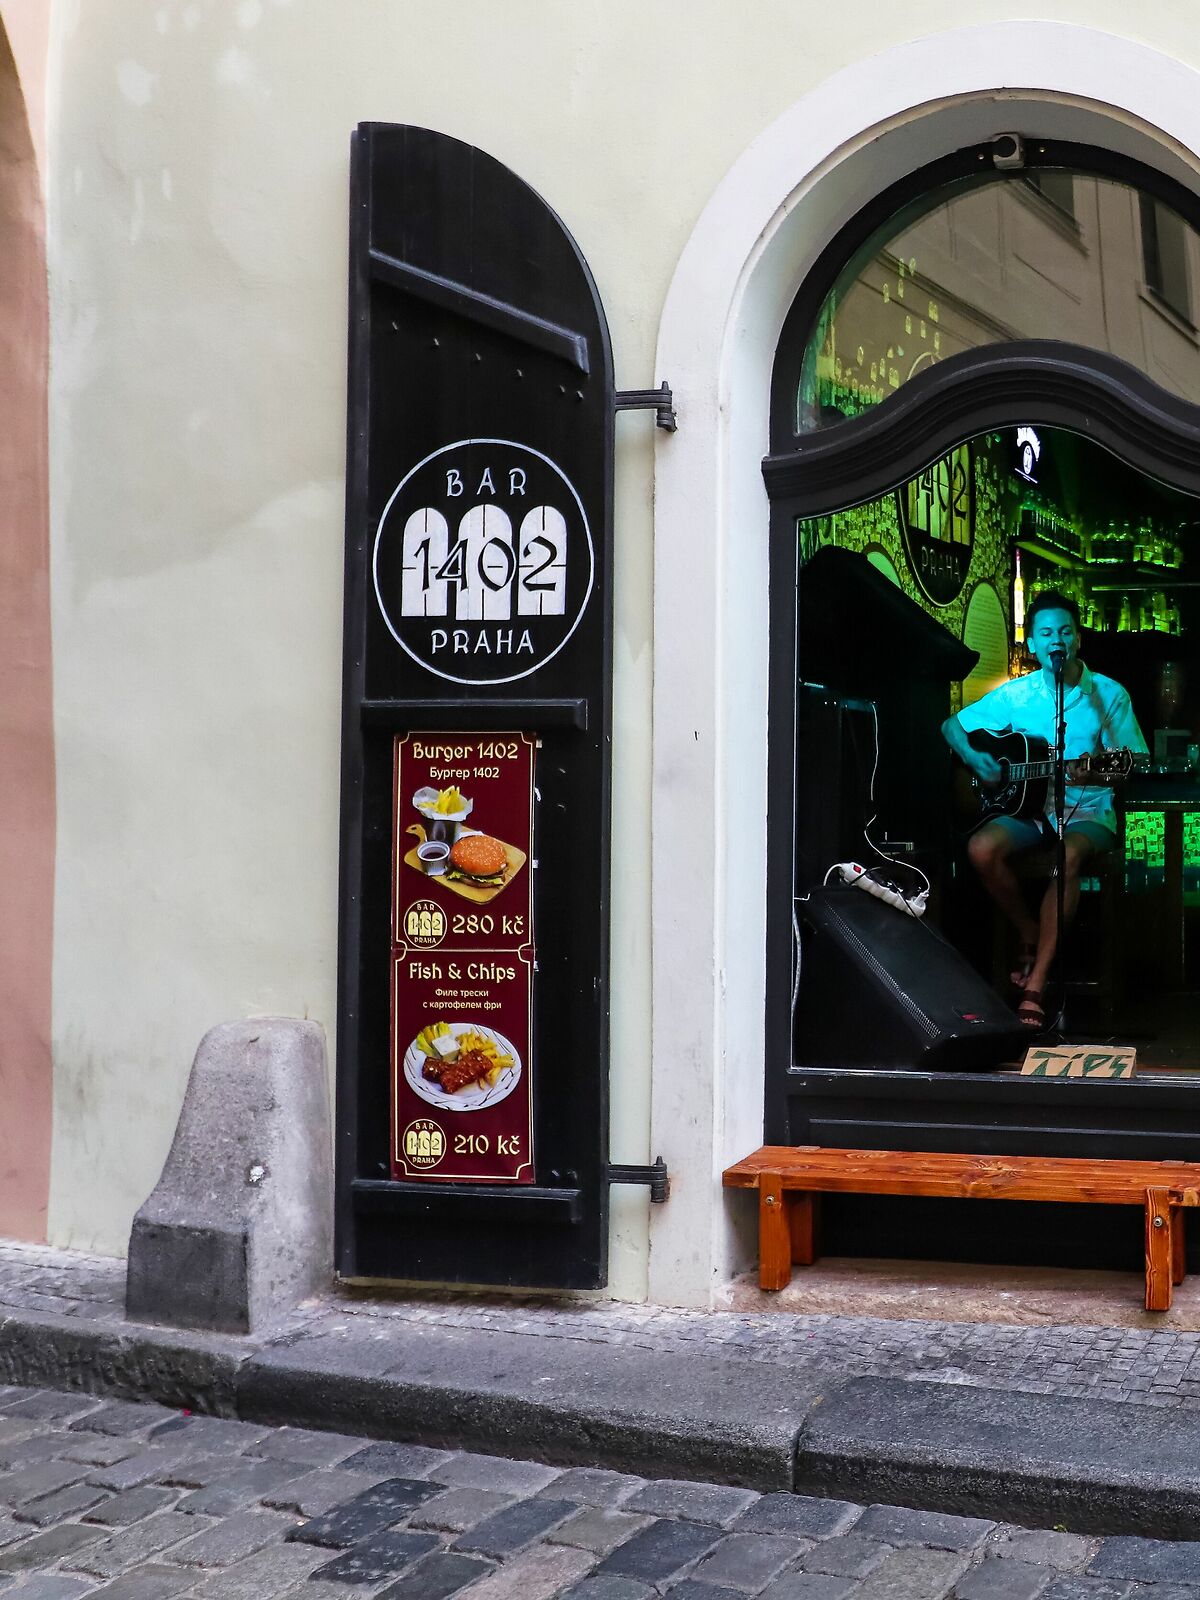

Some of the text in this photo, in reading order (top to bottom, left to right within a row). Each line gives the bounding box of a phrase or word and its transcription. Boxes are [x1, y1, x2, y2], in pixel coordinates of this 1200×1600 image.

[446, 467, 527, 497] BAR
[413, 535, 557, 592] 1402
[431, 628, 535, 655] PRAHA
[413, 742, 518, 762] Burger 1402
[430, 767, 500, 780] Бургер 1402
[416, 903, 435, 911] BAR
[452, 914, 524, 935] 280 kč
[414, 936, 437, 944] PRAHA
[409, 962, 516, 983] Fish & Chips
[435, 988, 489, 999] Филе трески
[429, 1000, 482, 1010] картофелем
[483, 1000, 502, 1010] фри
[415, 1122, 434, 1130] BAR
[454, 1134, 520, 1155] 210 kč
